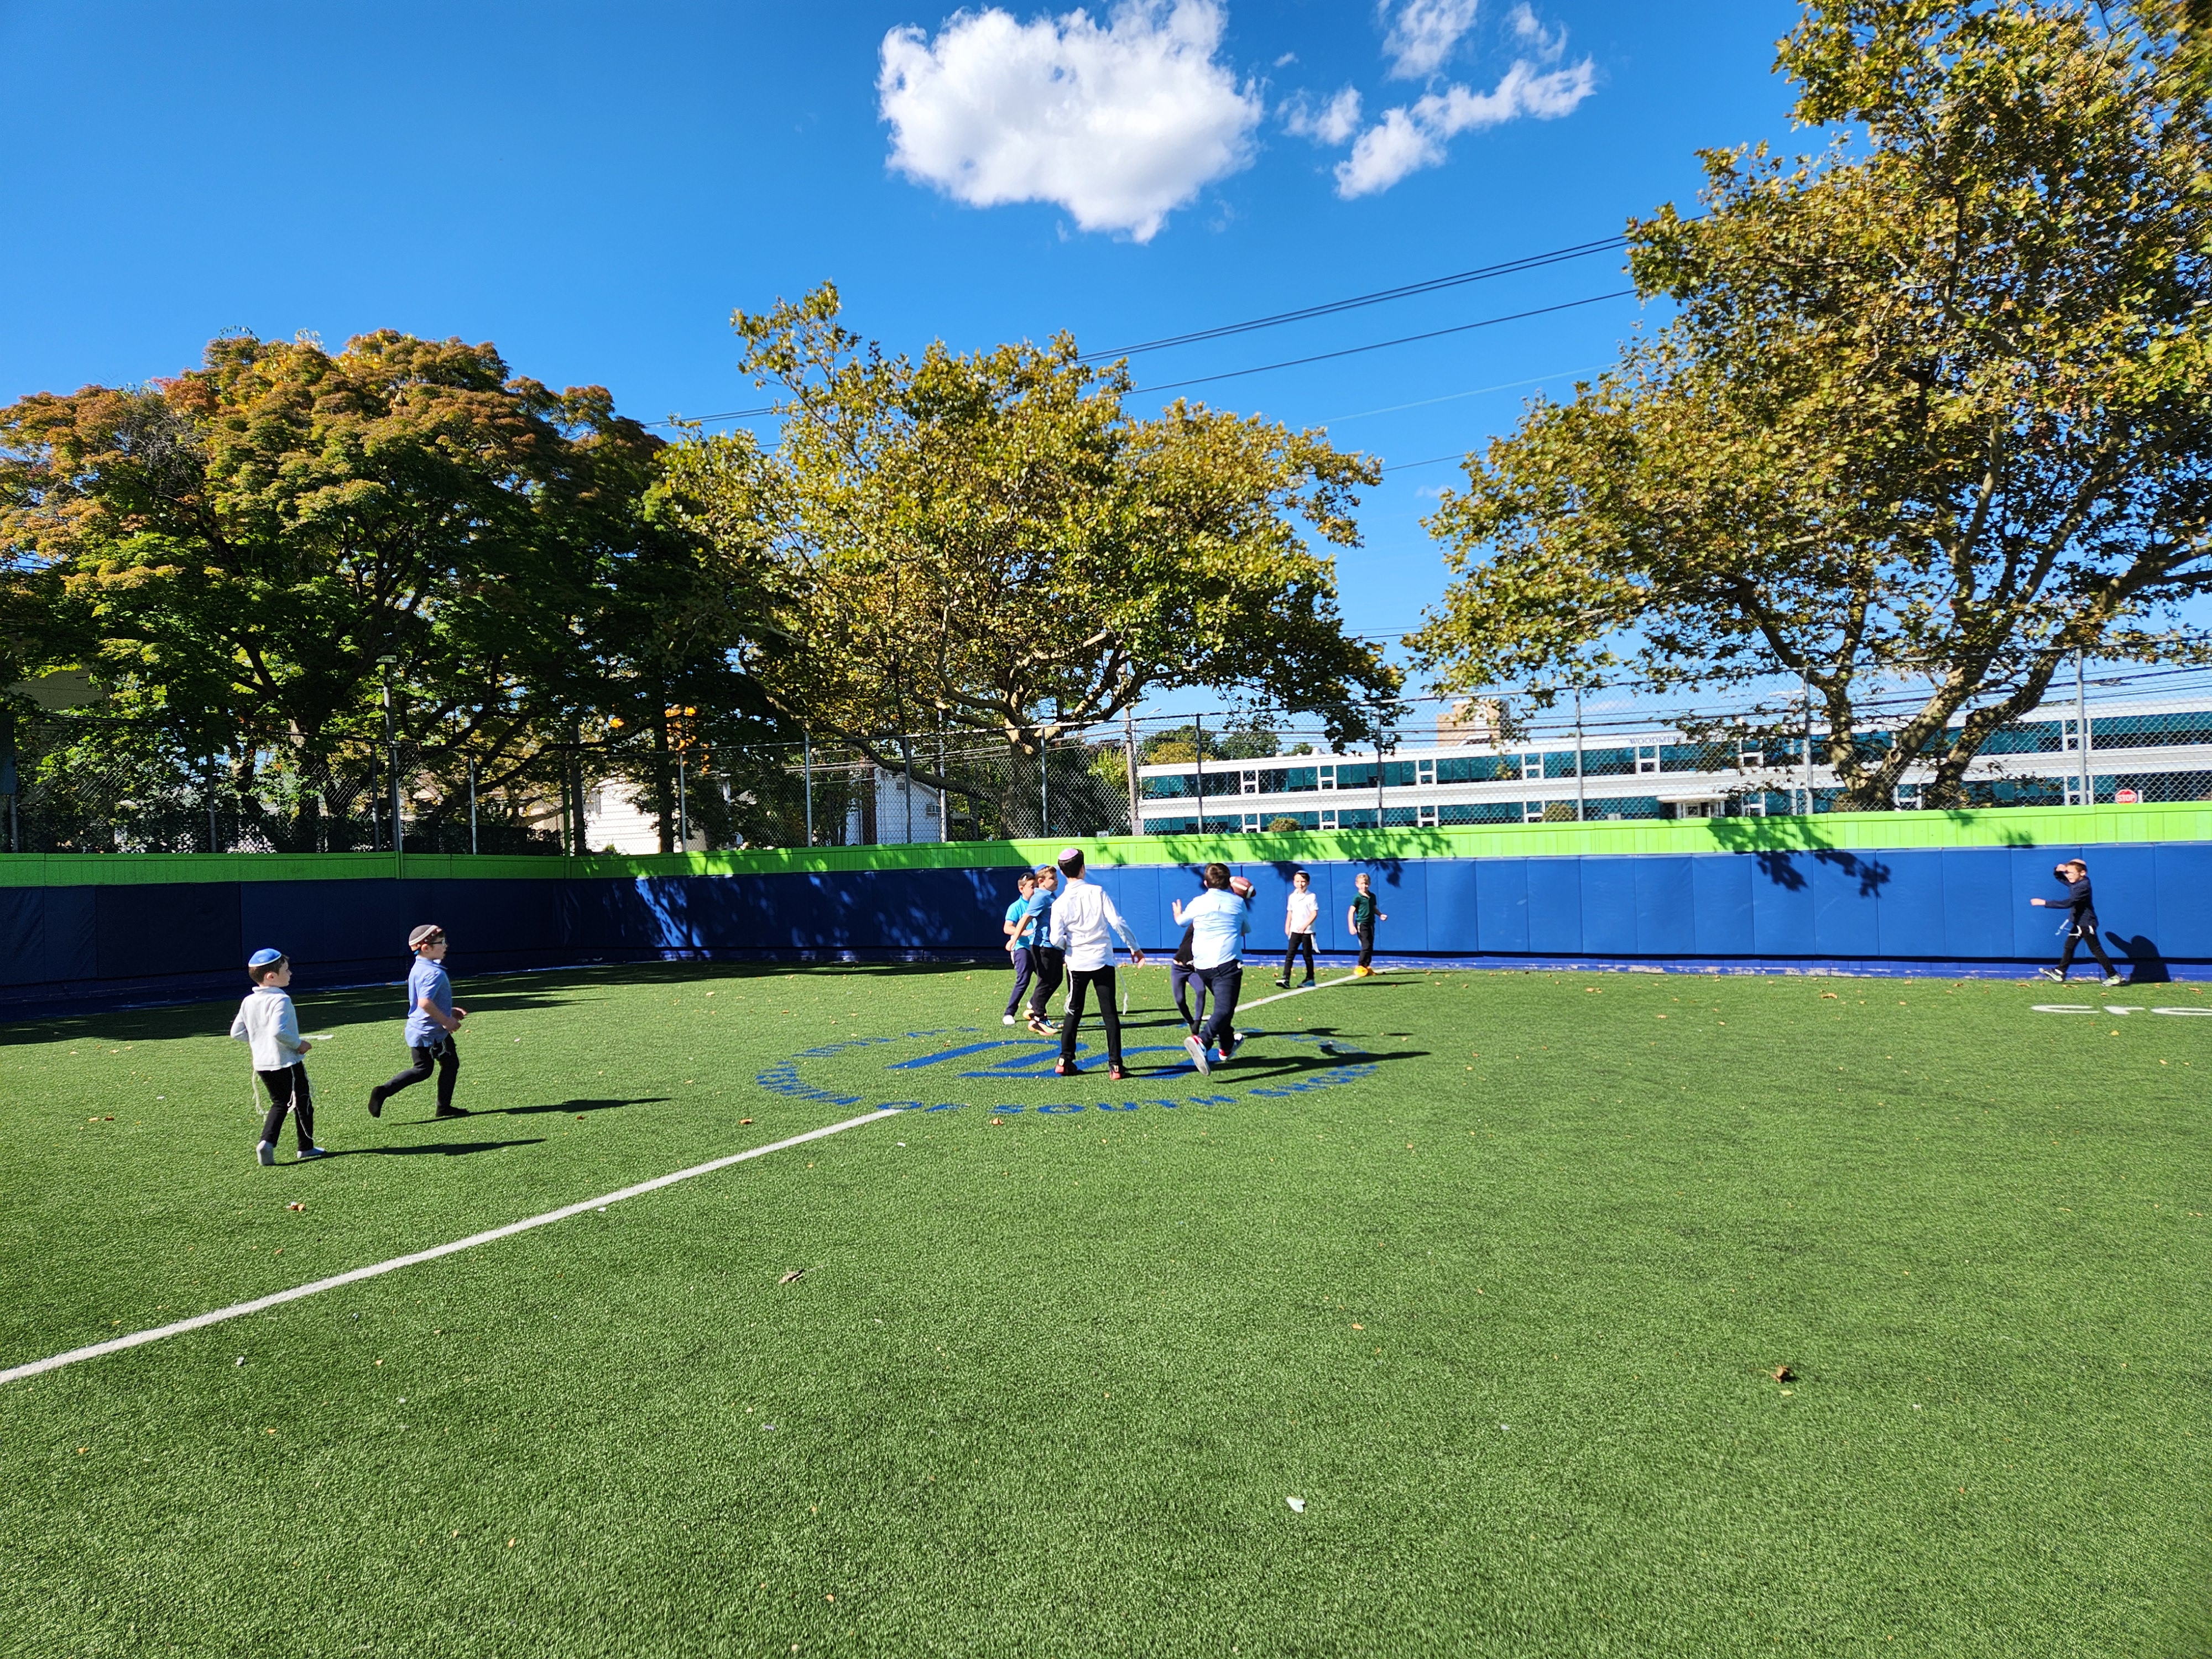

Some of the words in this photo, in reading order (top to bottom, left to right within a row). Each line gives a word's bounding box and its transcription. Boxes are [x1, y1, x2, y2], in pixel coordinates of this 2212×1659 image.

[1629, 736, 1684, 744] WOODMER
[876, 1101, 964, 1112] OF
[988, 1095, 1238, 1114] SOUTH
[1248, 1065, 1378, 1097] SHORE
